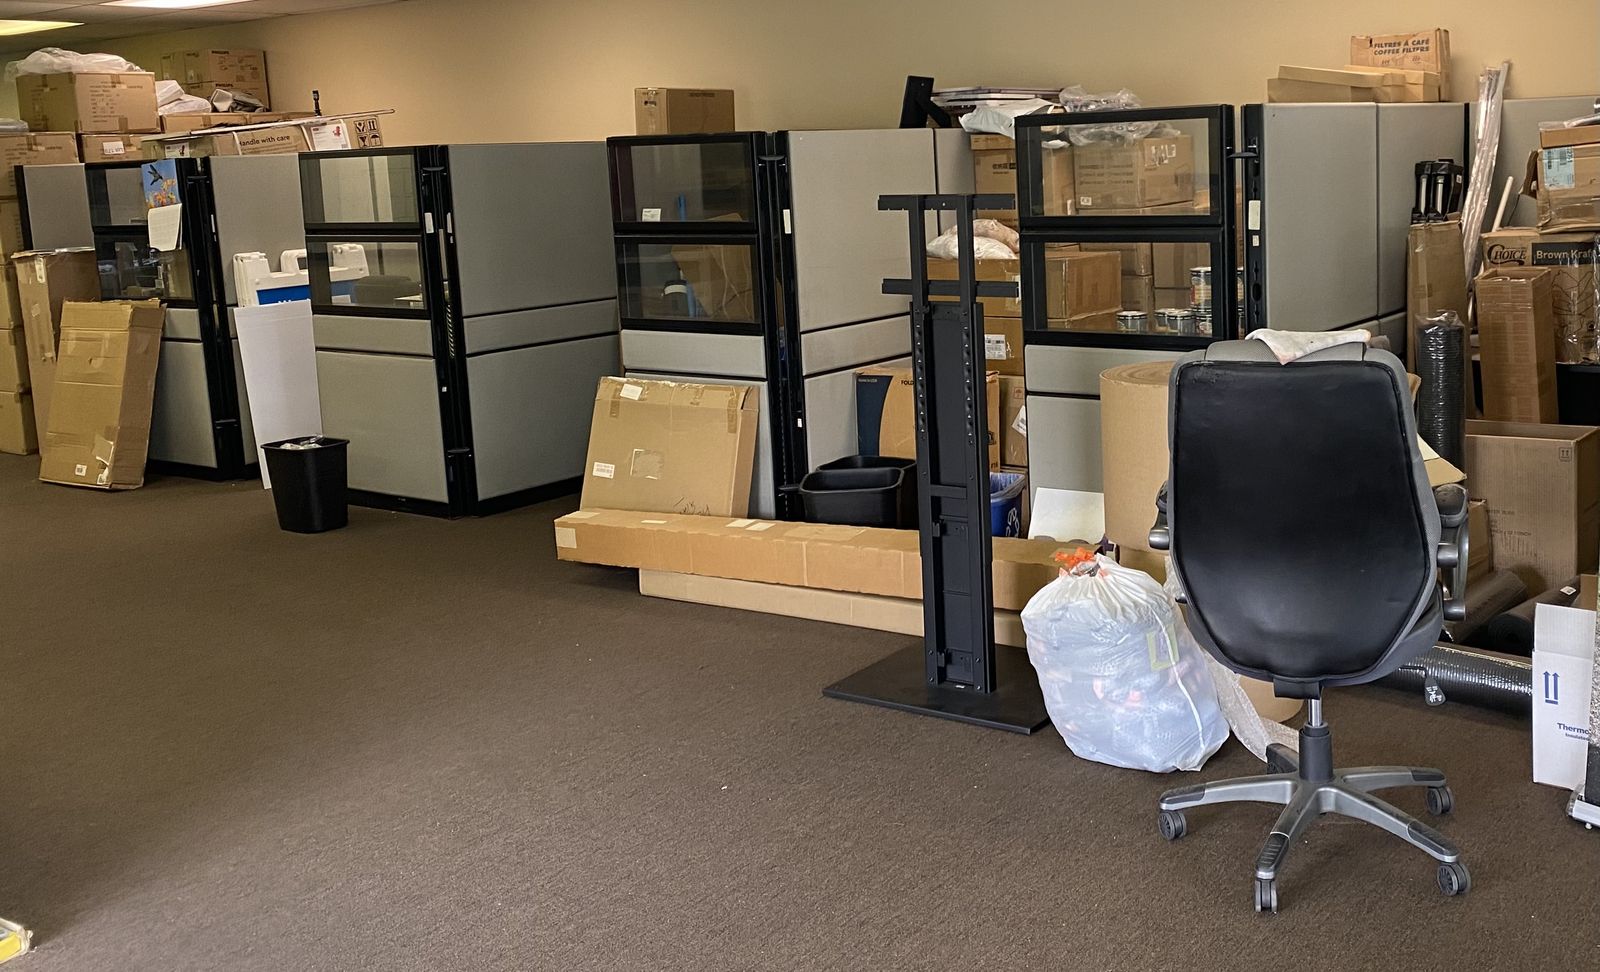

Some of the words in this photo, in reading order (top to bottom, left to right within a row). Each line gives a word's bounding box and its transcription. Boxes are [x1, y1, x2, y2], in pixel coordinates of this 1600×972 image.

[1374, 40, 1401, 48] FILTRES
[1536, 250, 1568, 259] Brown
[1571, 249, 1597, 259] Kraf
